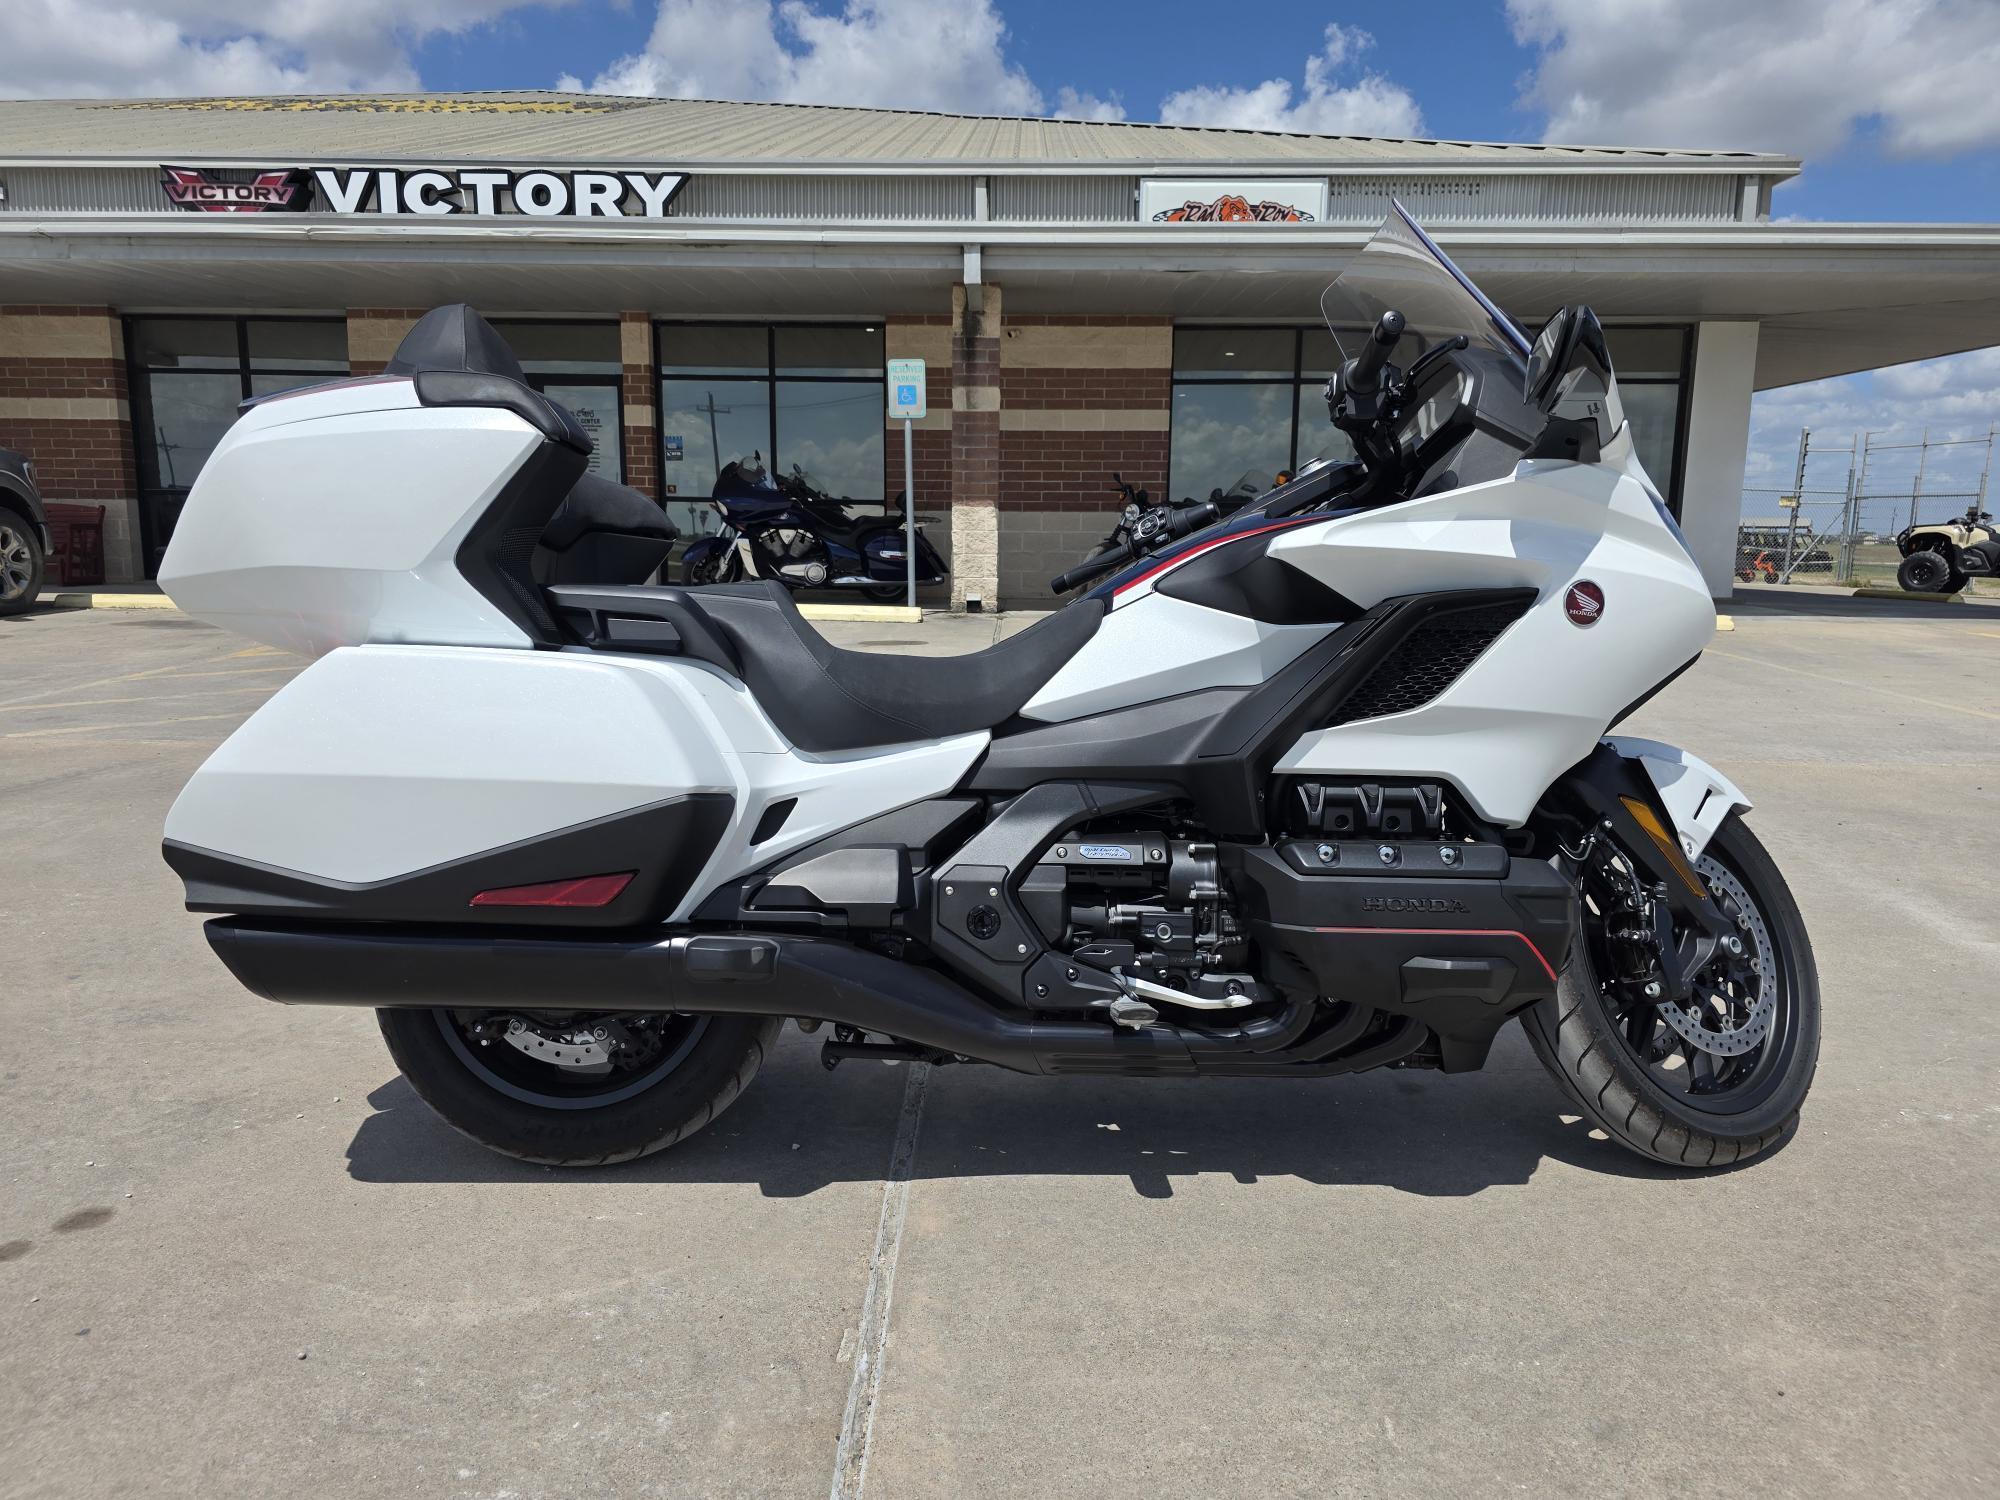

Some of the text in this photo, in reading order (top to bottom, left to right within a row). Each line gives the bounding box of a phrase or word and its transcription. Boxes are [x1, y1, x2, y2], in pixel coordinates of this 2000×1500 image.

[171, 185, 289, 202] VICTORY
[314, 171, 684, 217] VICTORY
[1569, 609, 1598, 618] HONDA
[1360, 897, 1471, 914] HONDA
